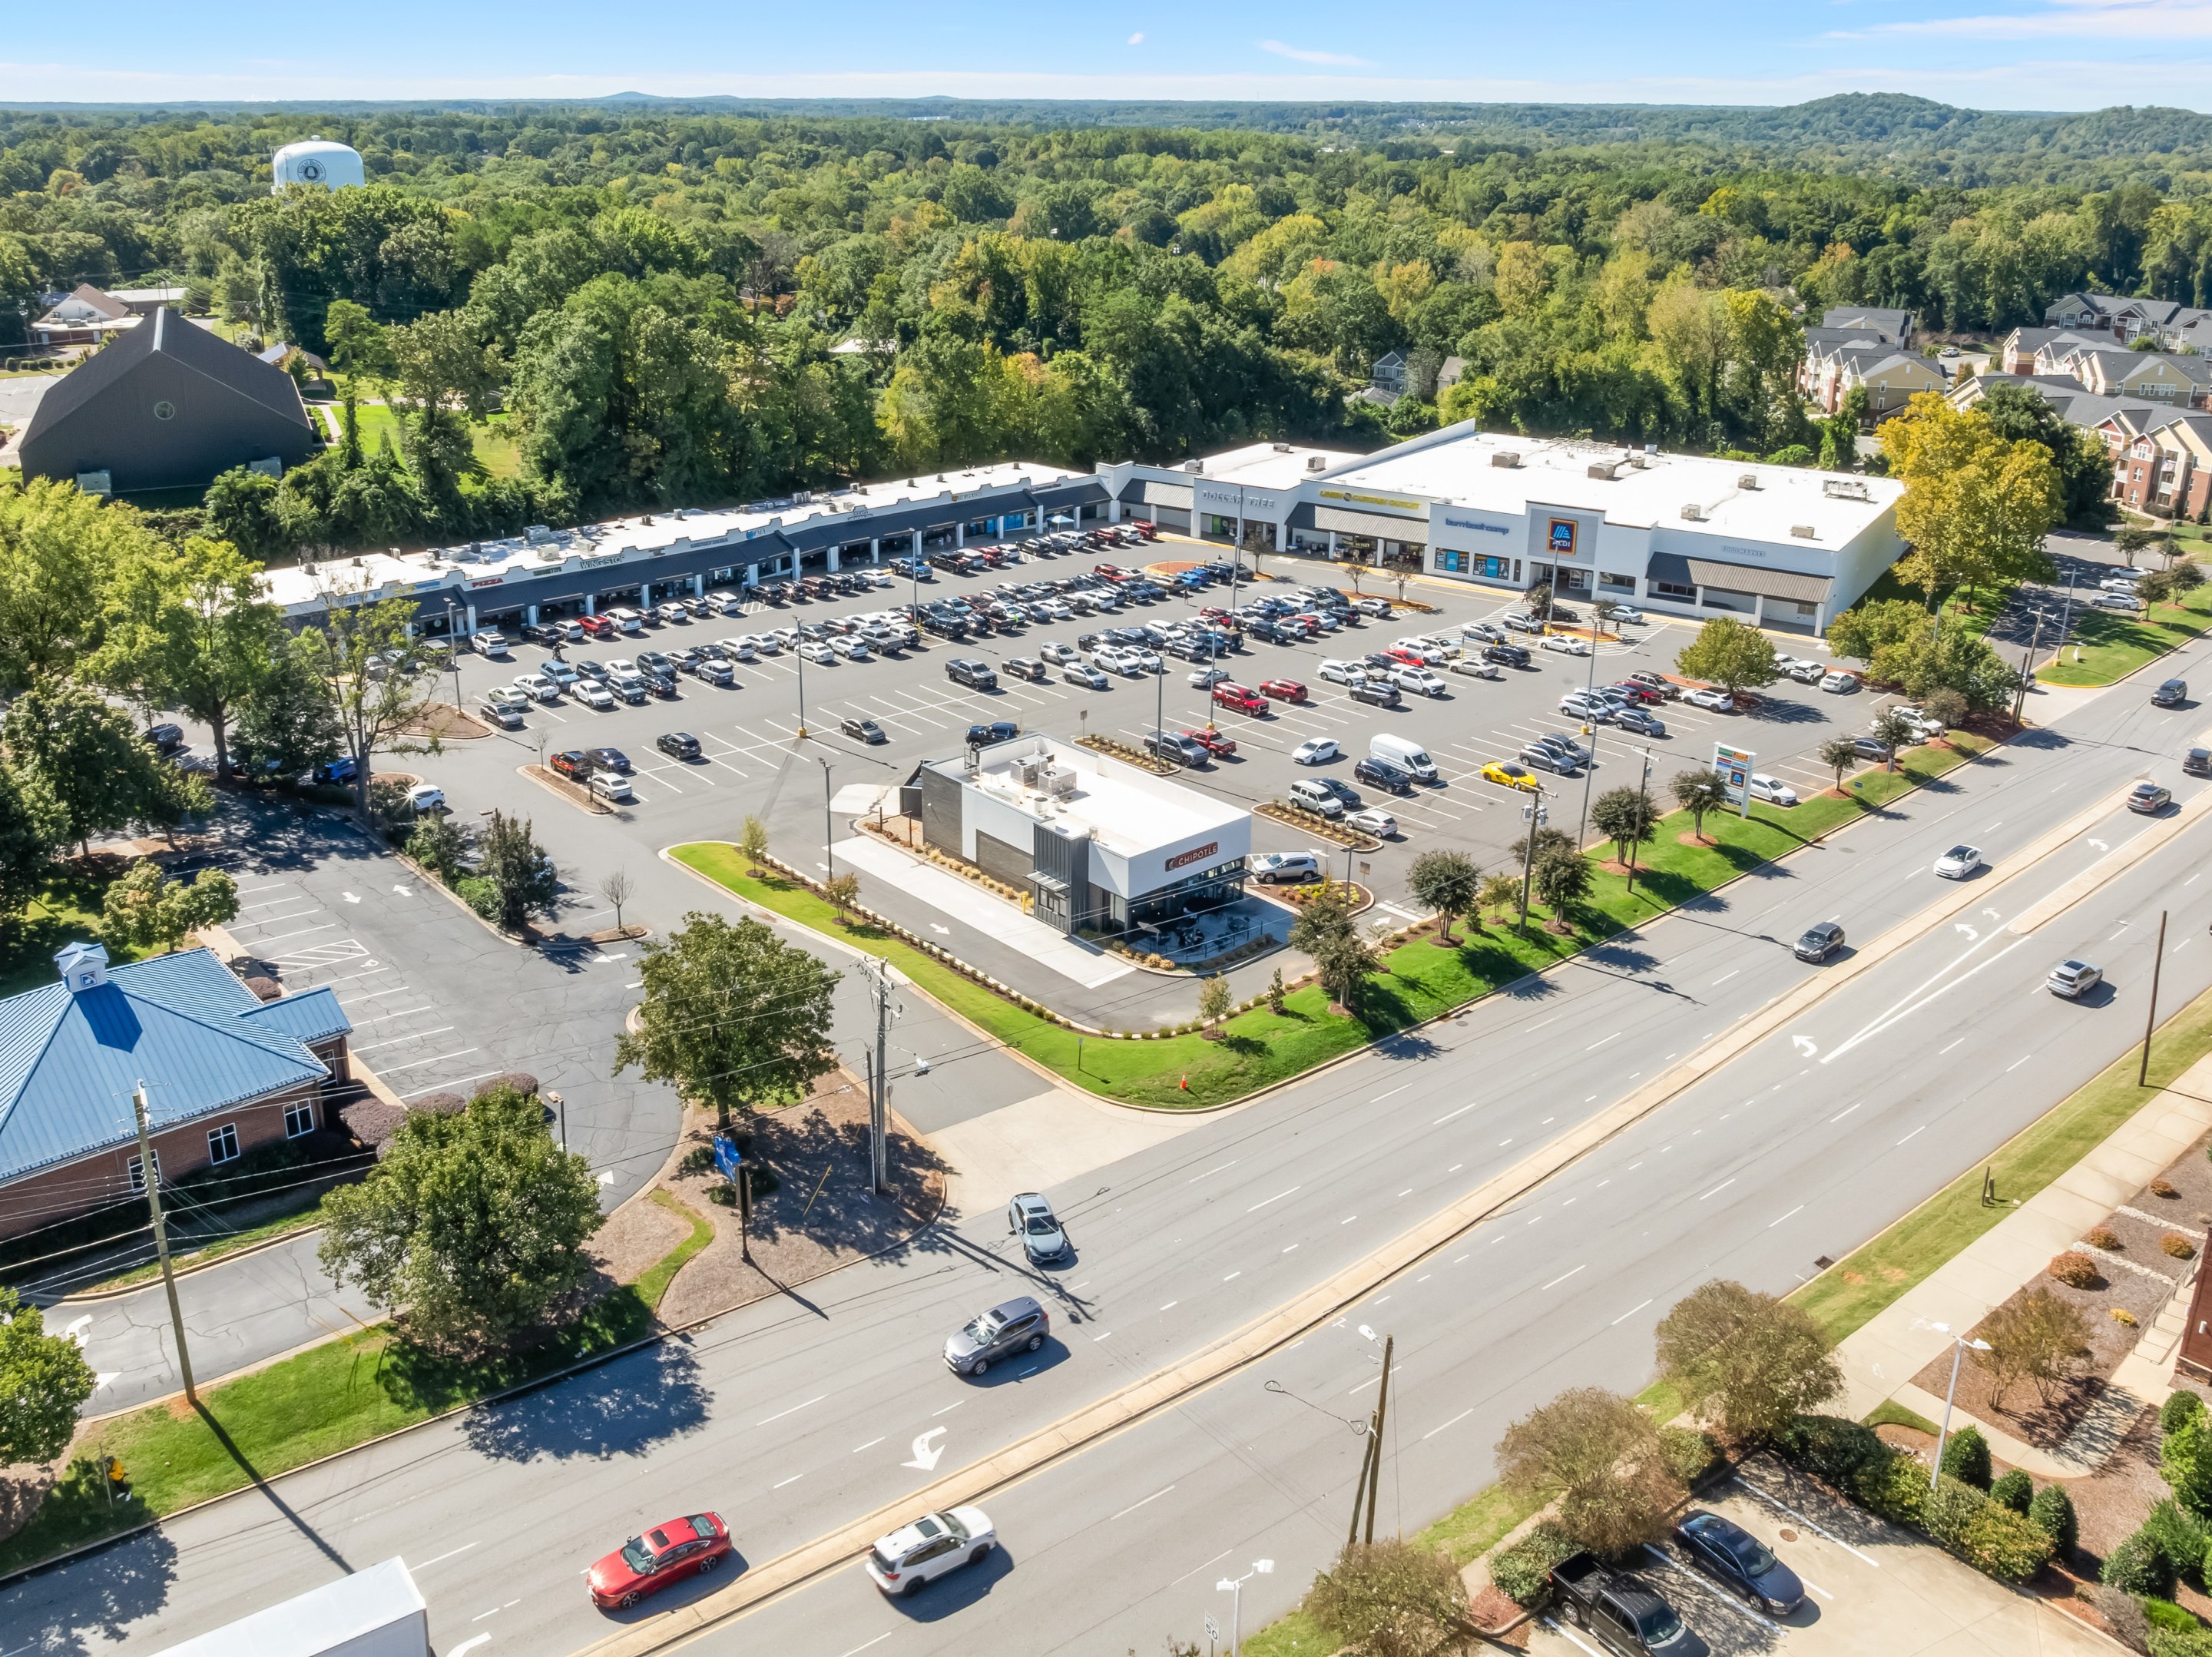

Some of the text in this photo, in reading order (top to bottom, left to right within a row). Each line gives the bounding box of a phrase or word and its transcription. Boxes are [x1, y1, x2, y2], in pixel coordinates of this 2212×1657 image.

[1202, 489, 1274, 508] DOLLAR TREE
[472, 578, 504, 588] PIZZA
[1178, 845, 1217, 866] CHIPOTLE
[1205, 1623, 1218, 1640] 50
